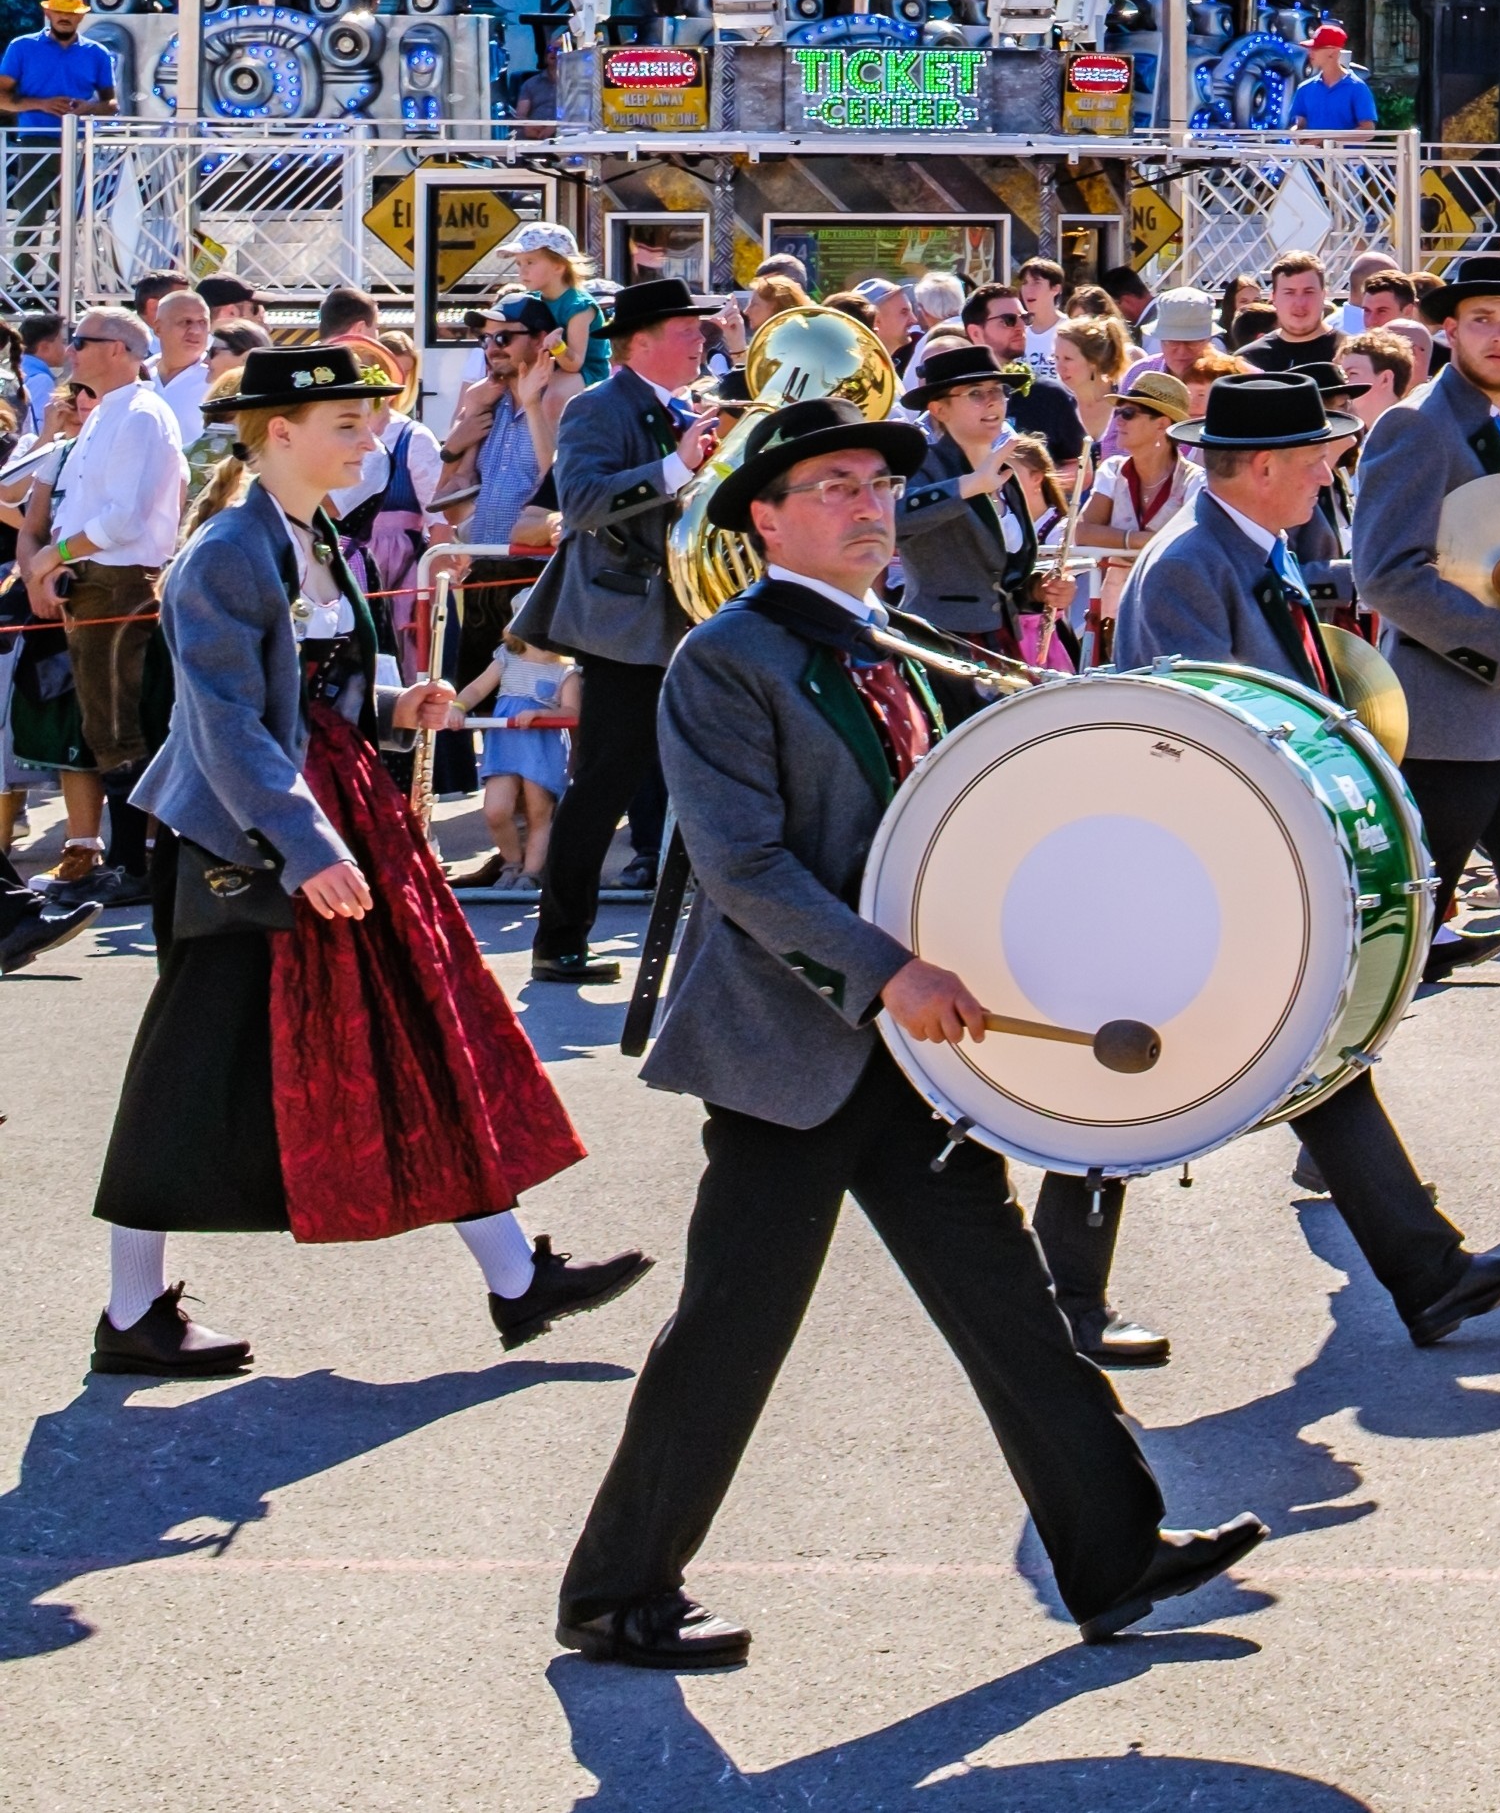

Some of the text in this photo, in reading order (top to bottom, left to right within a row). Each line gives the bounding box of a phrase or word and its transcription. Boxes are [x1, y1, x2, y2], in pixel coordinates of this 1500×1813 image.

[610, 61, 696, 77] WARNING
[792, 49, 989, 95] TICKET
[624, 93, 685, 107] KEEP AWAY
[613, 112, 667, 126] PREDATOR
[820, 97, 961, 129] CENTER
[393, 198, 489, 229] EIANG
